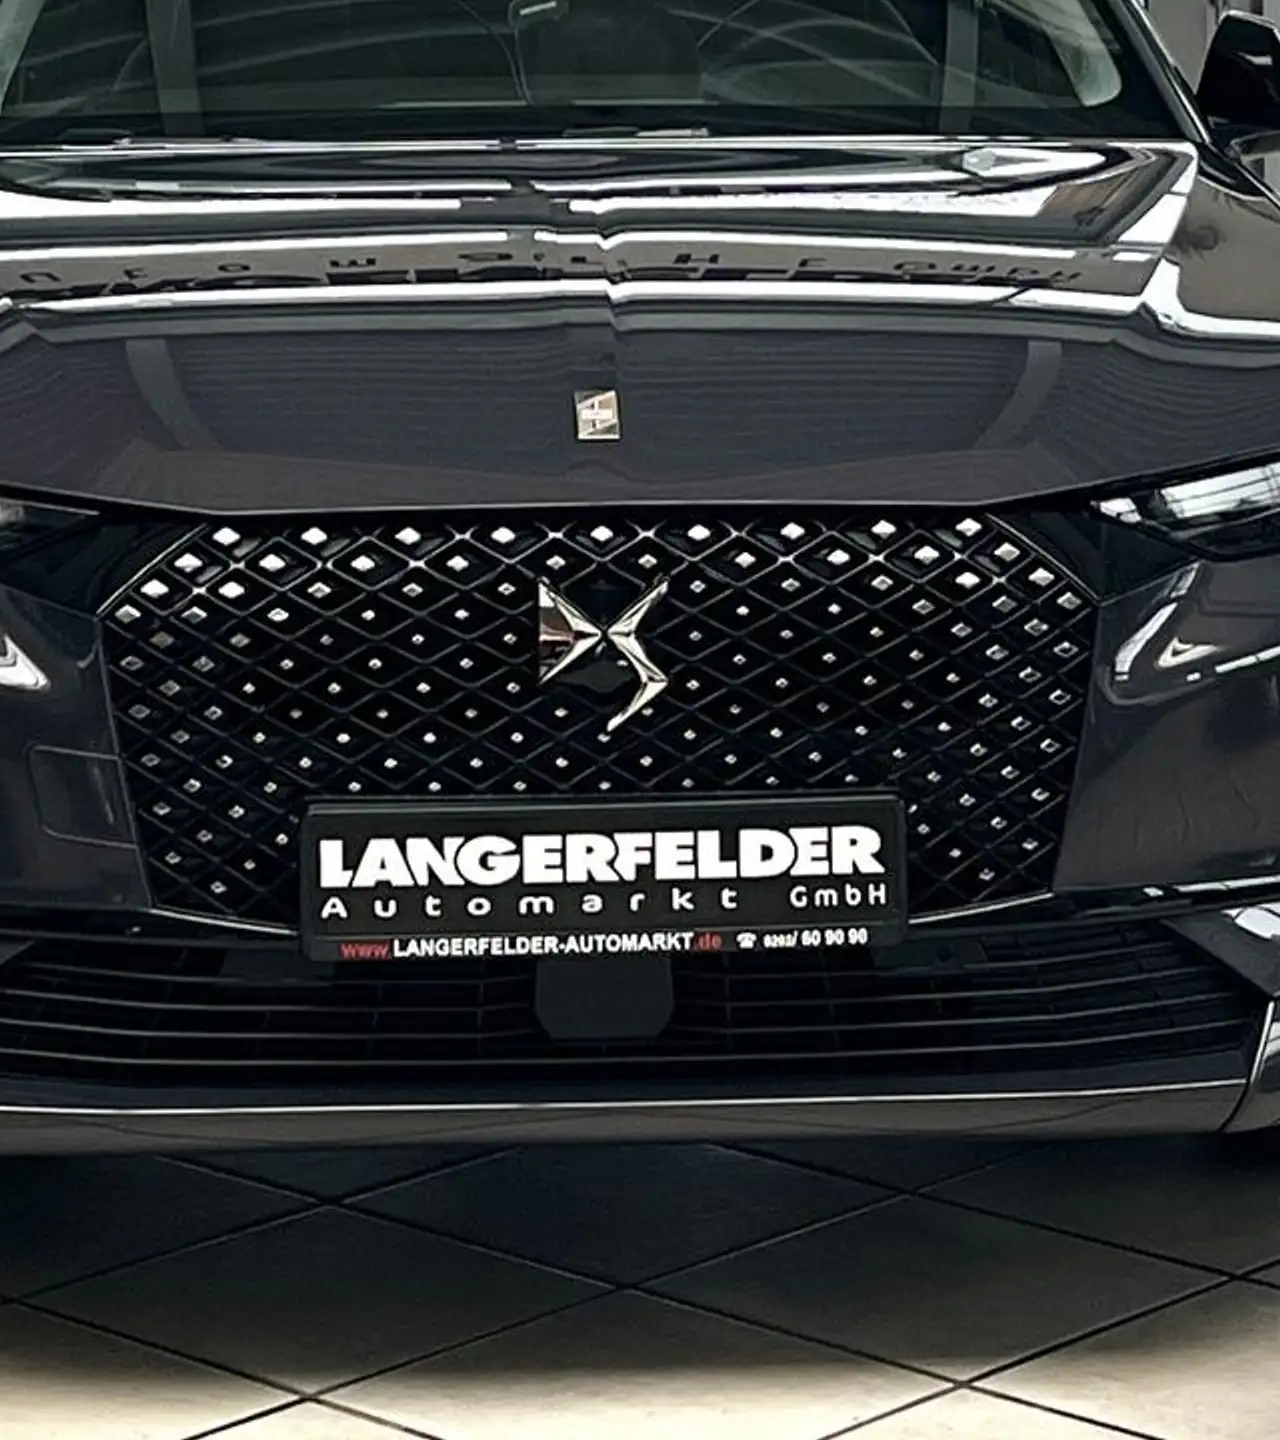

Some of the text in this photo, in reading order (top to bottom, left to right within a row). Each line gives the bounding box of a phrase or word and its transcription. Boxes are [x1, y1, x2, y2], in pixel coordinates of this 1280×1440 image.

[319, 825, 886, 889] LANGERFELDER
[320, 882, 887, 920] Automarkt GmbH
